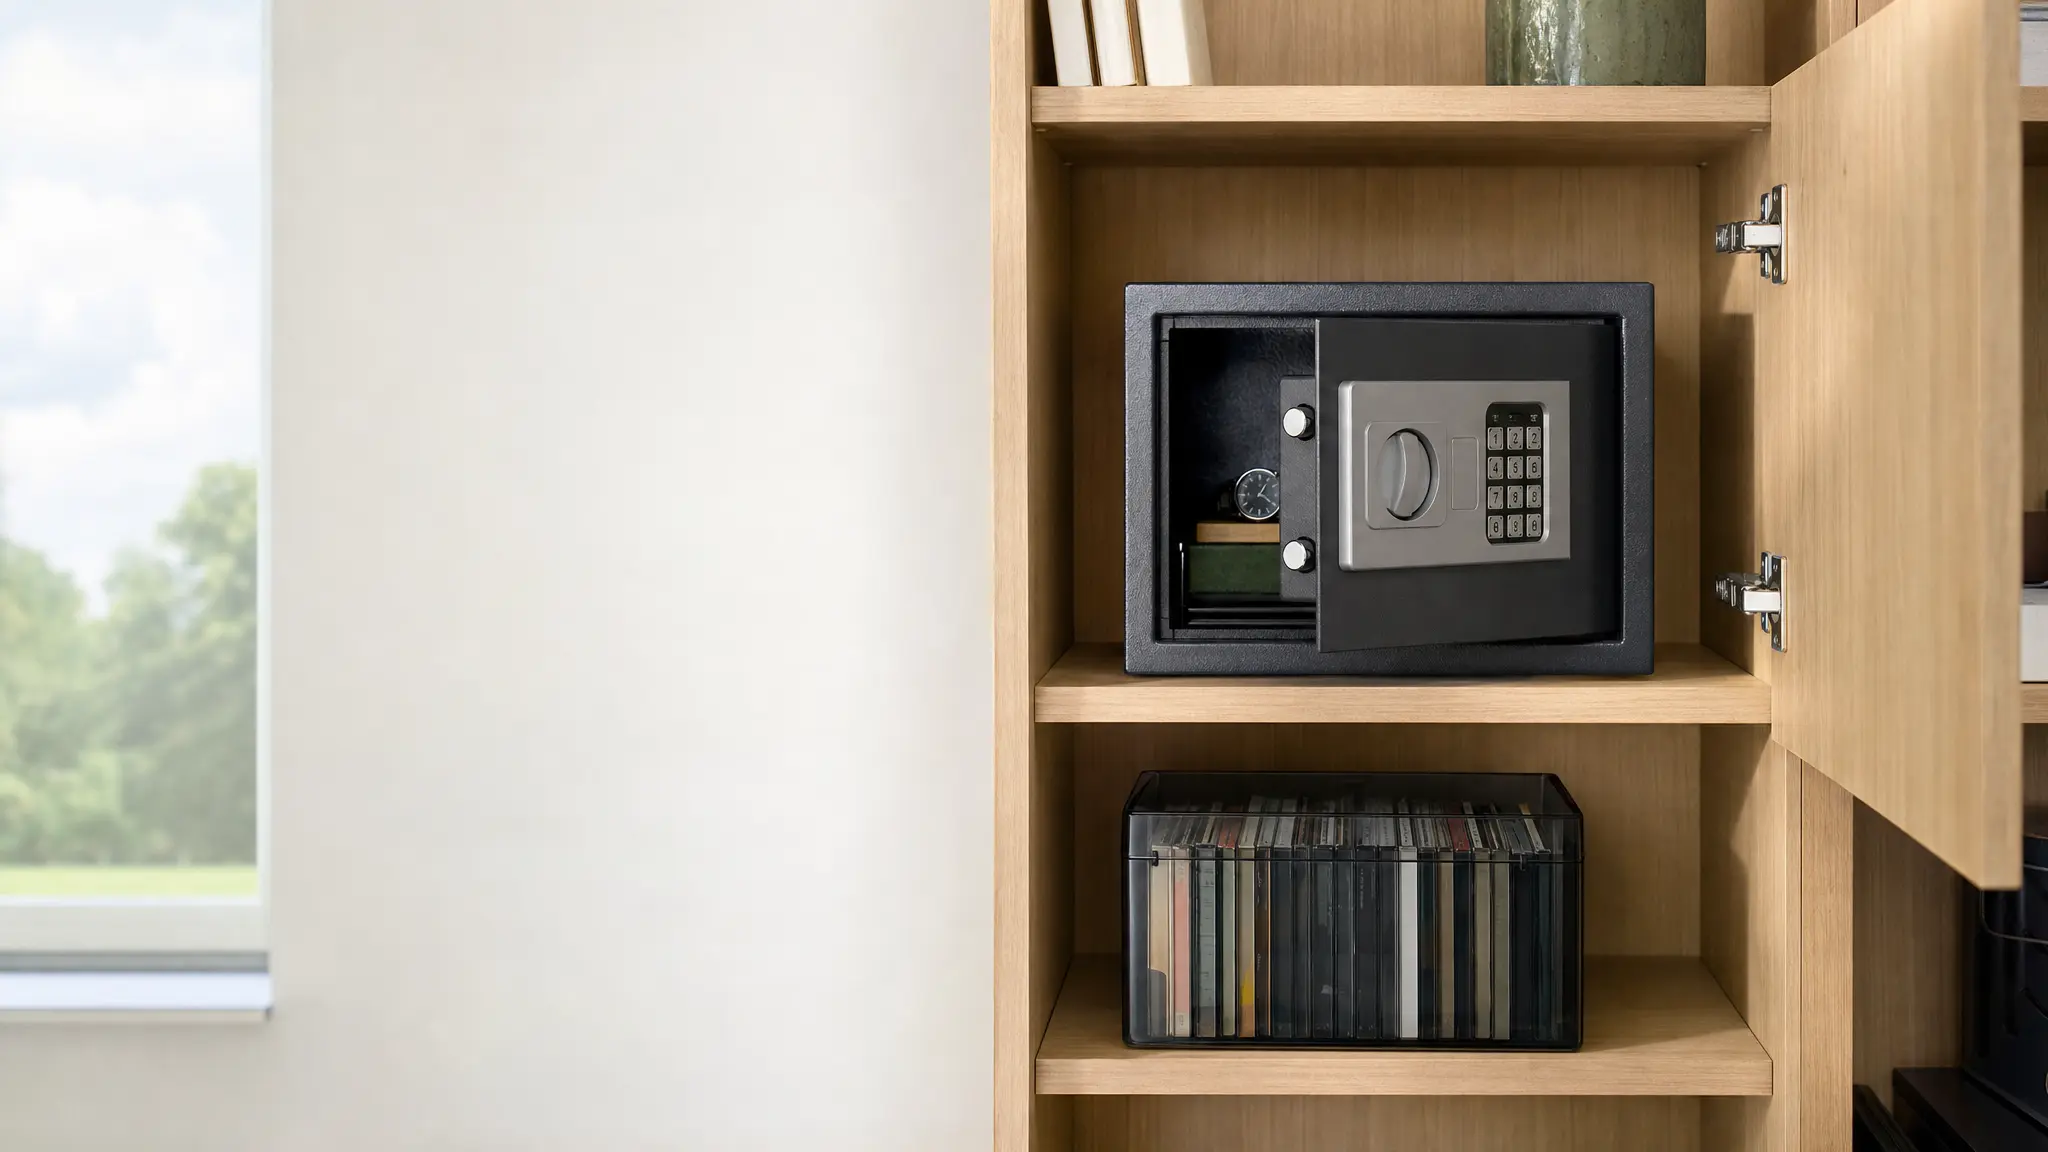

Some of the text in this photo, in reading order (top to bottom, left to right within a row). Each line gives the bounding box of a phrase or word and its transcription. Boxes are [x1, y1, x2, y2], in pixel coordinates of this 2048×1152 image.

[1493, 433, 1498, 444] 1
[1493, 462, 1537, 474] 4 5 6
[1493, 492, 1498, 503] 7
